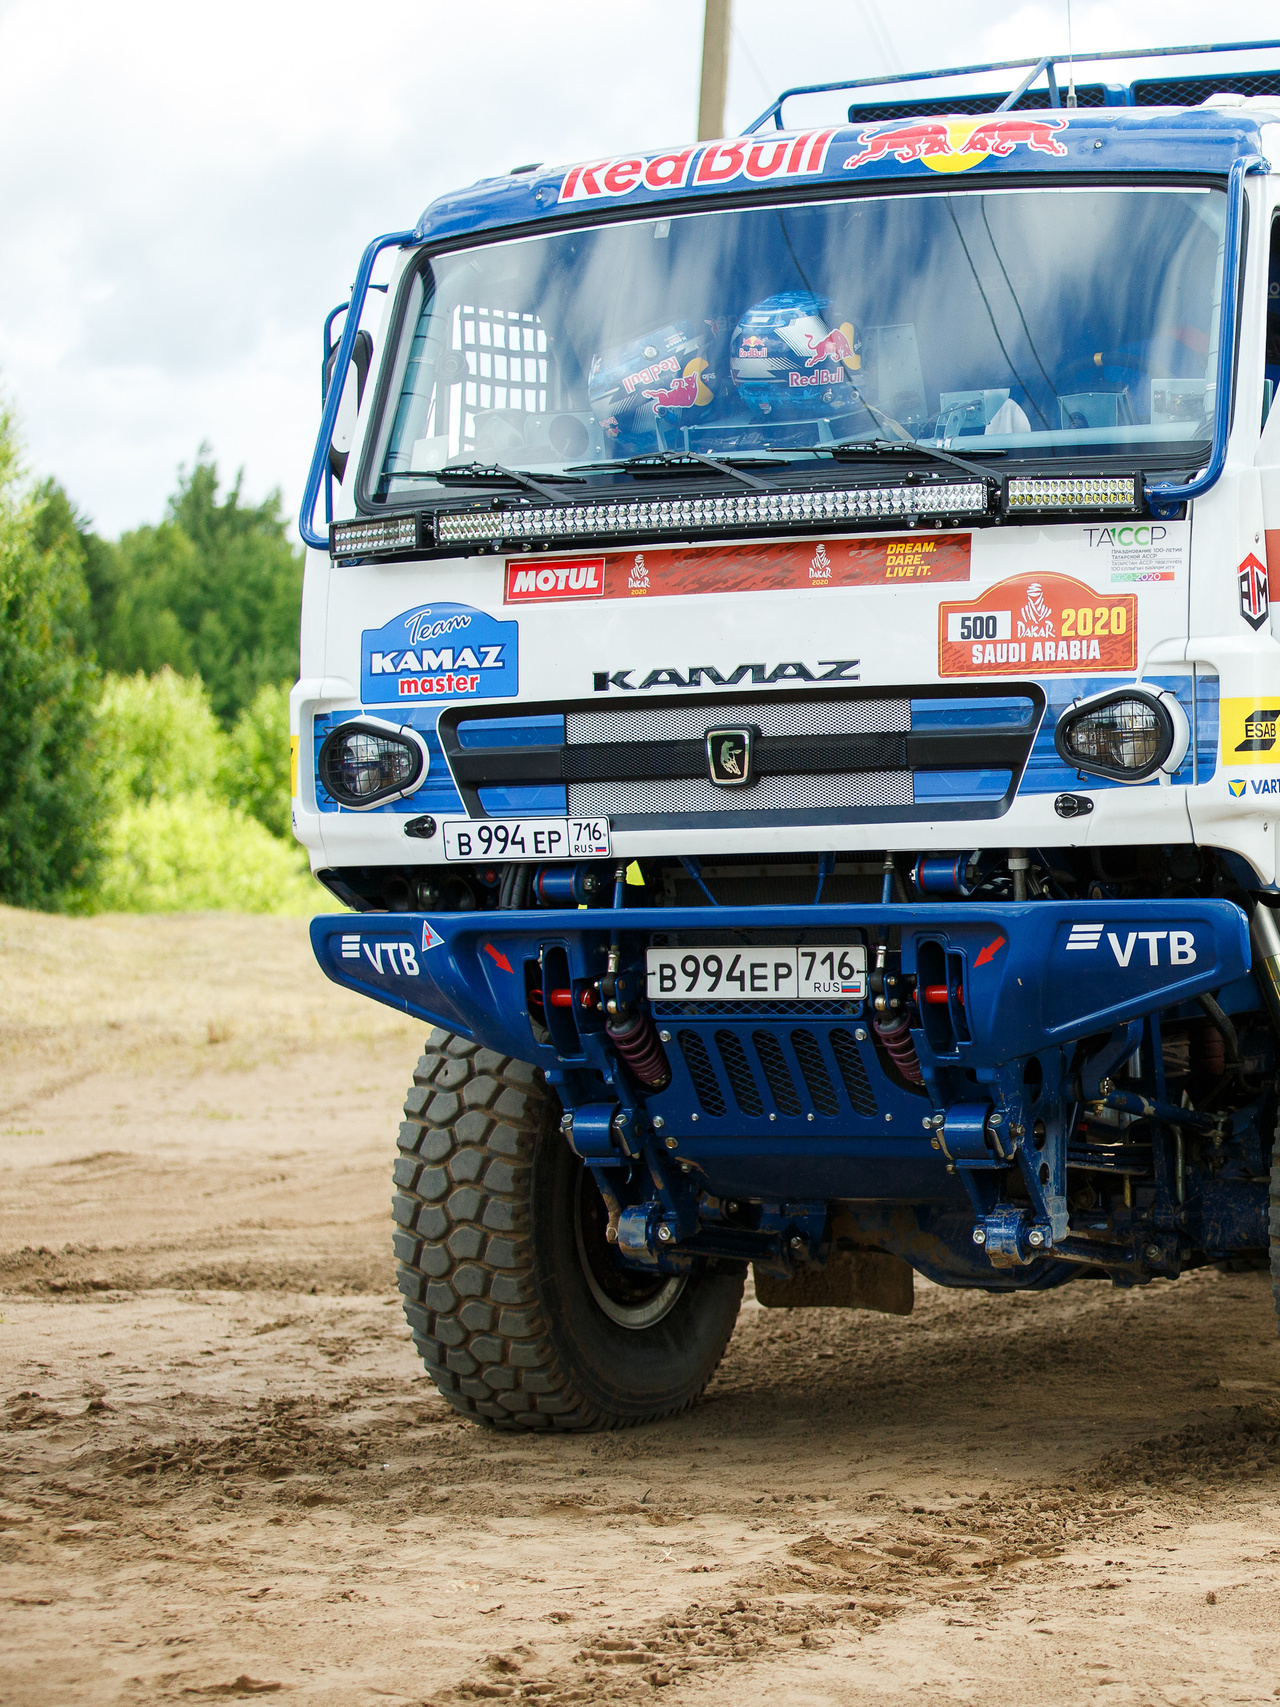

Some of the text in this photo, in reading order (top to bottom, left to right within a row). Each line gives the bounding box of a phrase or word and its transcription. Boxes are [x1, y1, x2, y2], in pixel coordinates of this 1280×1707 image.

[559, 127, 840, 203] Red Bull
[739, 346, 768, 358] Red Bull
[622, 356, 681, 394] Red Bull
[789, 366, 844, 387] Red Bull
[886, 543, 937, 555] DREAM.
[886, 555, 926, 567] DARE.
[513, 567, 599, 593] MOTUL
[808, 566, 833, 579] DAKAR
[885, 565, 932, 578] LIVE IT.
[1112, 572, 1161, 581] 1920-2020
[628, 577, 651, 589] DAKAR
[811, 578, 829, 586] 2020
[404, 607, 471, 645] Team
[959, 615, 997, 640] 500
[1017, 620, 1055, 638] DAKAR
[1061, 606, 1127, 637] 2020
[371, 646, 503, 674] KAMAZ
[971, 639, 1100, 664] SAUDI ARABIA
[399, 674, 479, 694] master
[592, 659, 861, 692] KAMAZ
[1245, 721, 1277, 738] ESAB
[573, 822, 602, 842] 716
[574, 844, 594, 853] RUS
[1106, 930, 1197, 967] VTB
[362, 942, 420, 976] VTB
[801, 951, 855, 981] 716
[813, 981, 840, 993] RUS
